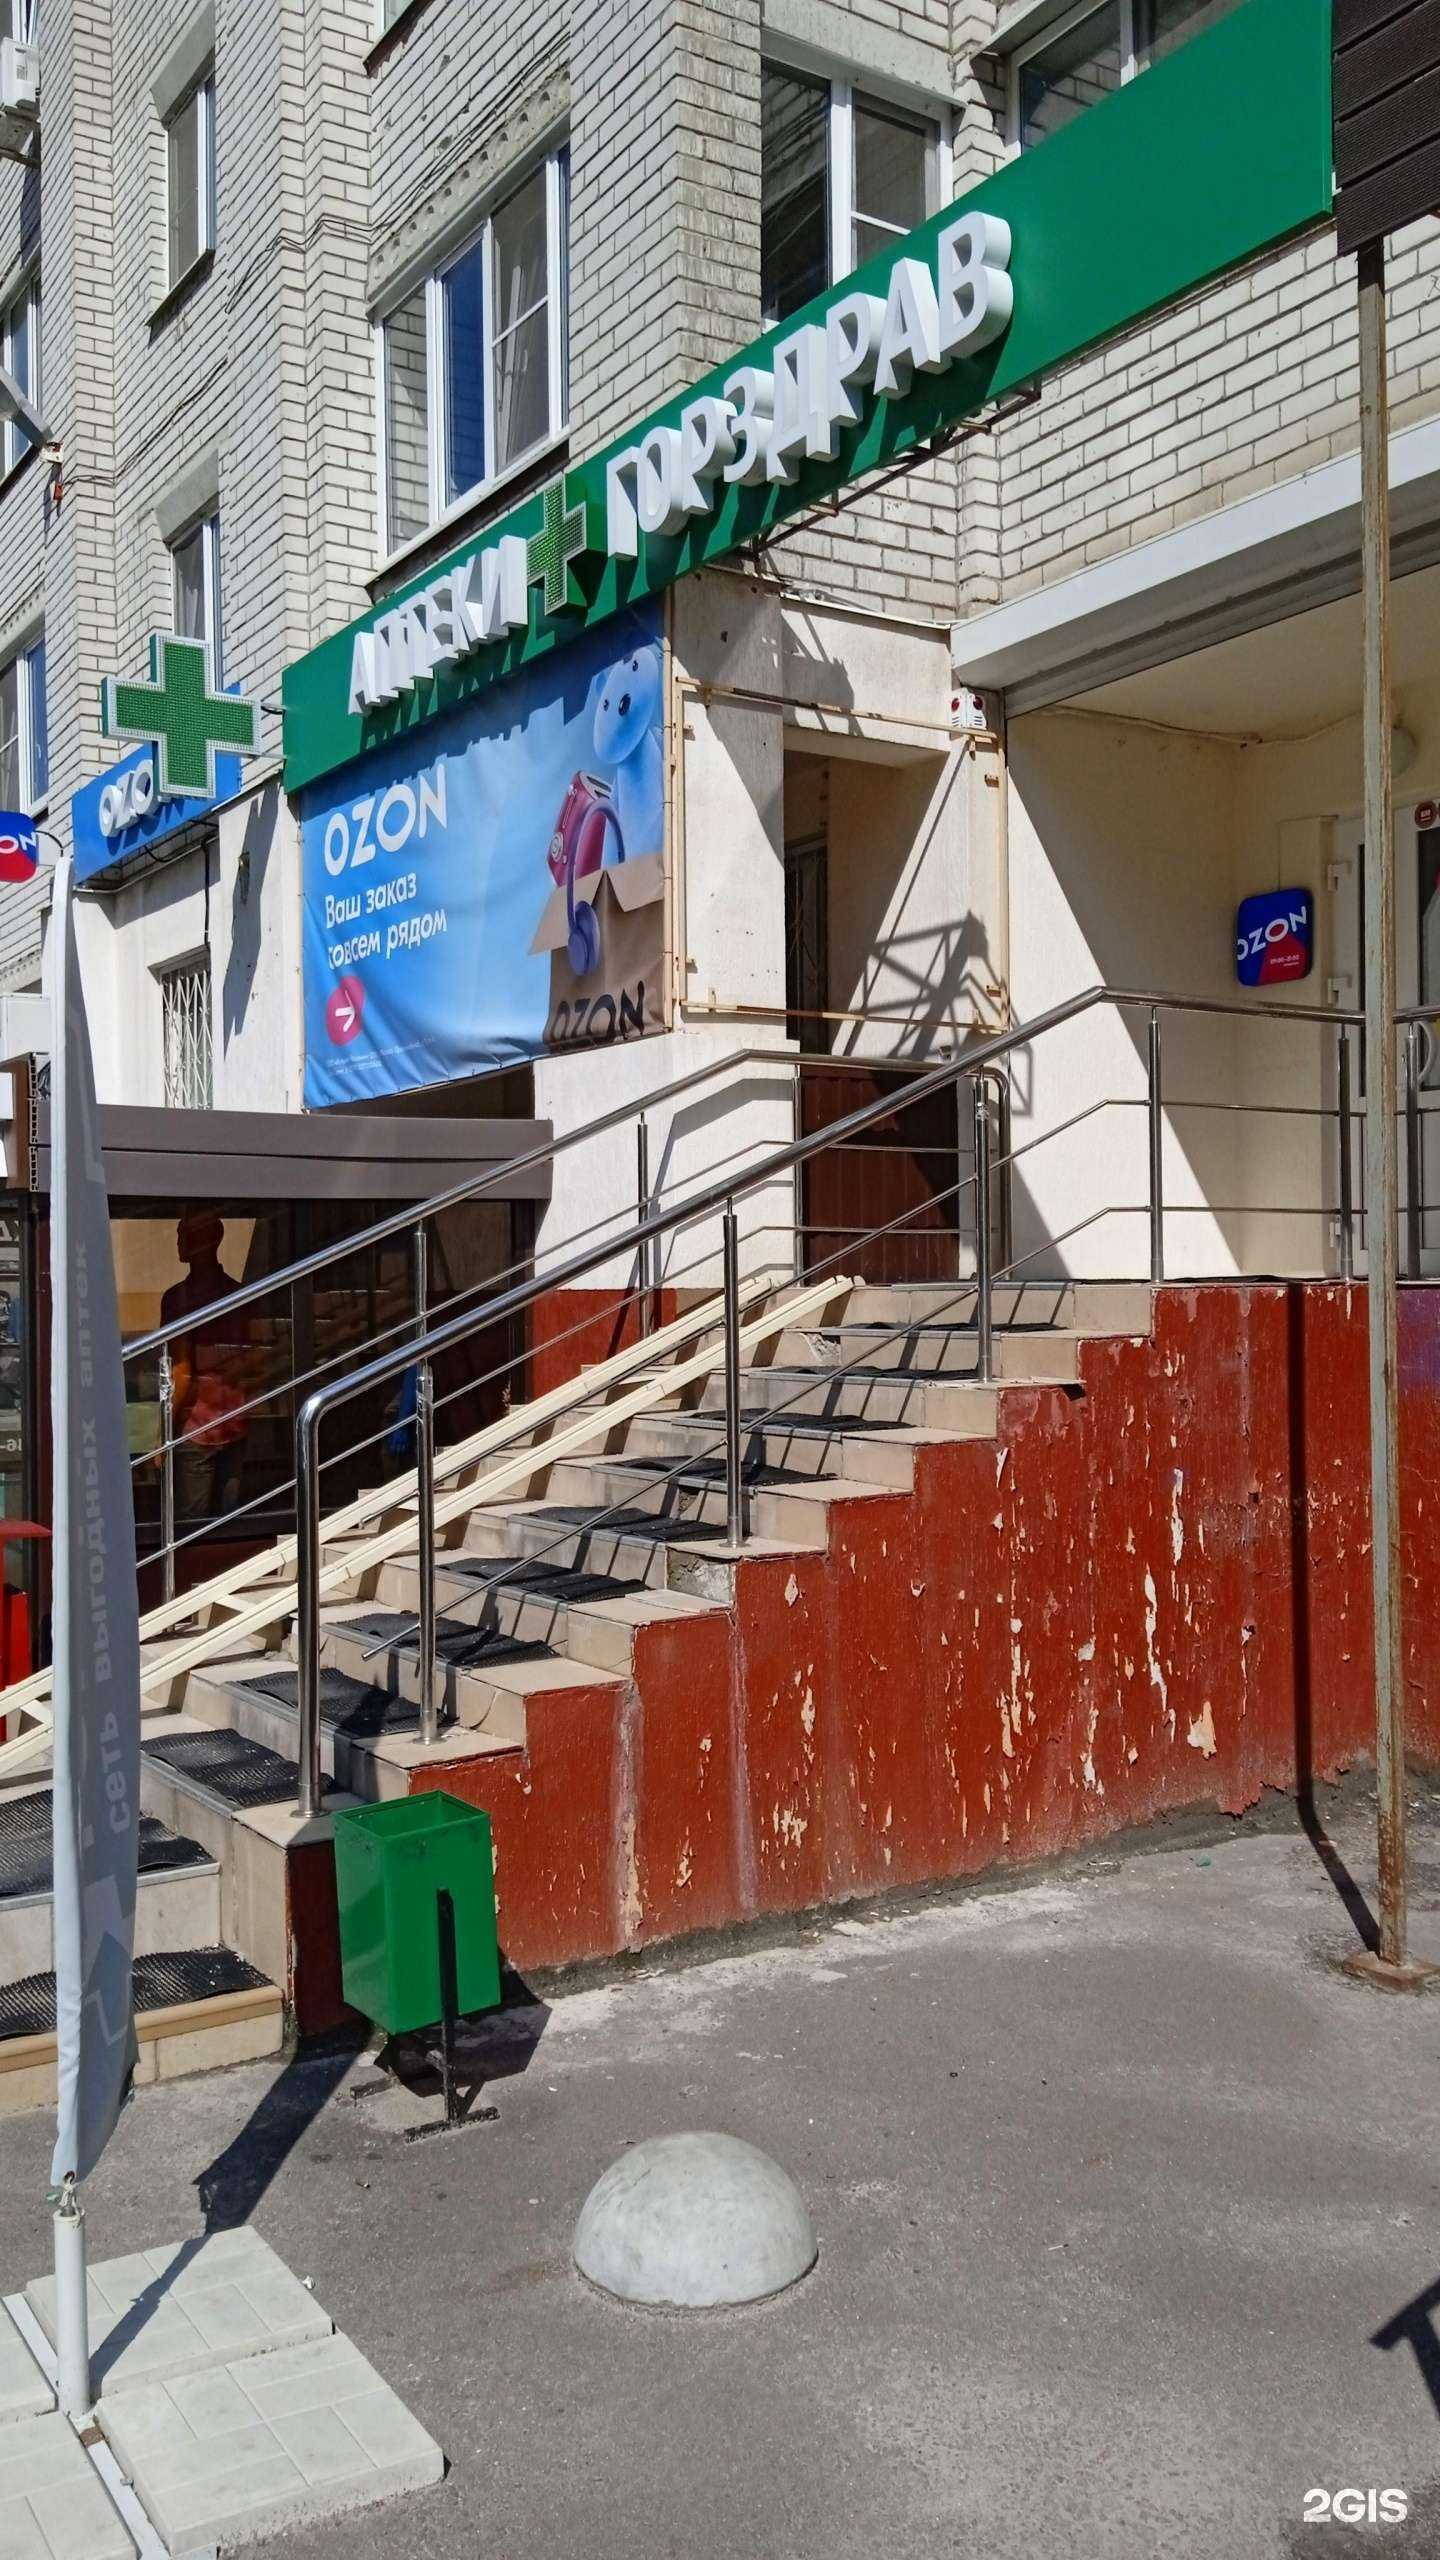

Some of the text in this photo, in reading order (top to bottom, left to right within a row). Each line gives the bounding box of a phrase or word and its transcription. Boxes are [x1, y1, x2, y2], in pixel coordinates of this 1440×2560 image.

[348, 210, 1014, 716] АПТЕКИ ГОРЗДРАВ
[99, 759, 172, 837] OZO
[324, 763, 448, 877] OZON
[325, 872, 417, 929] Ваш заказ
[385, 908, 447, 960] рядом
[75, 1240, 132, 1834] сеть выгодных аптек
